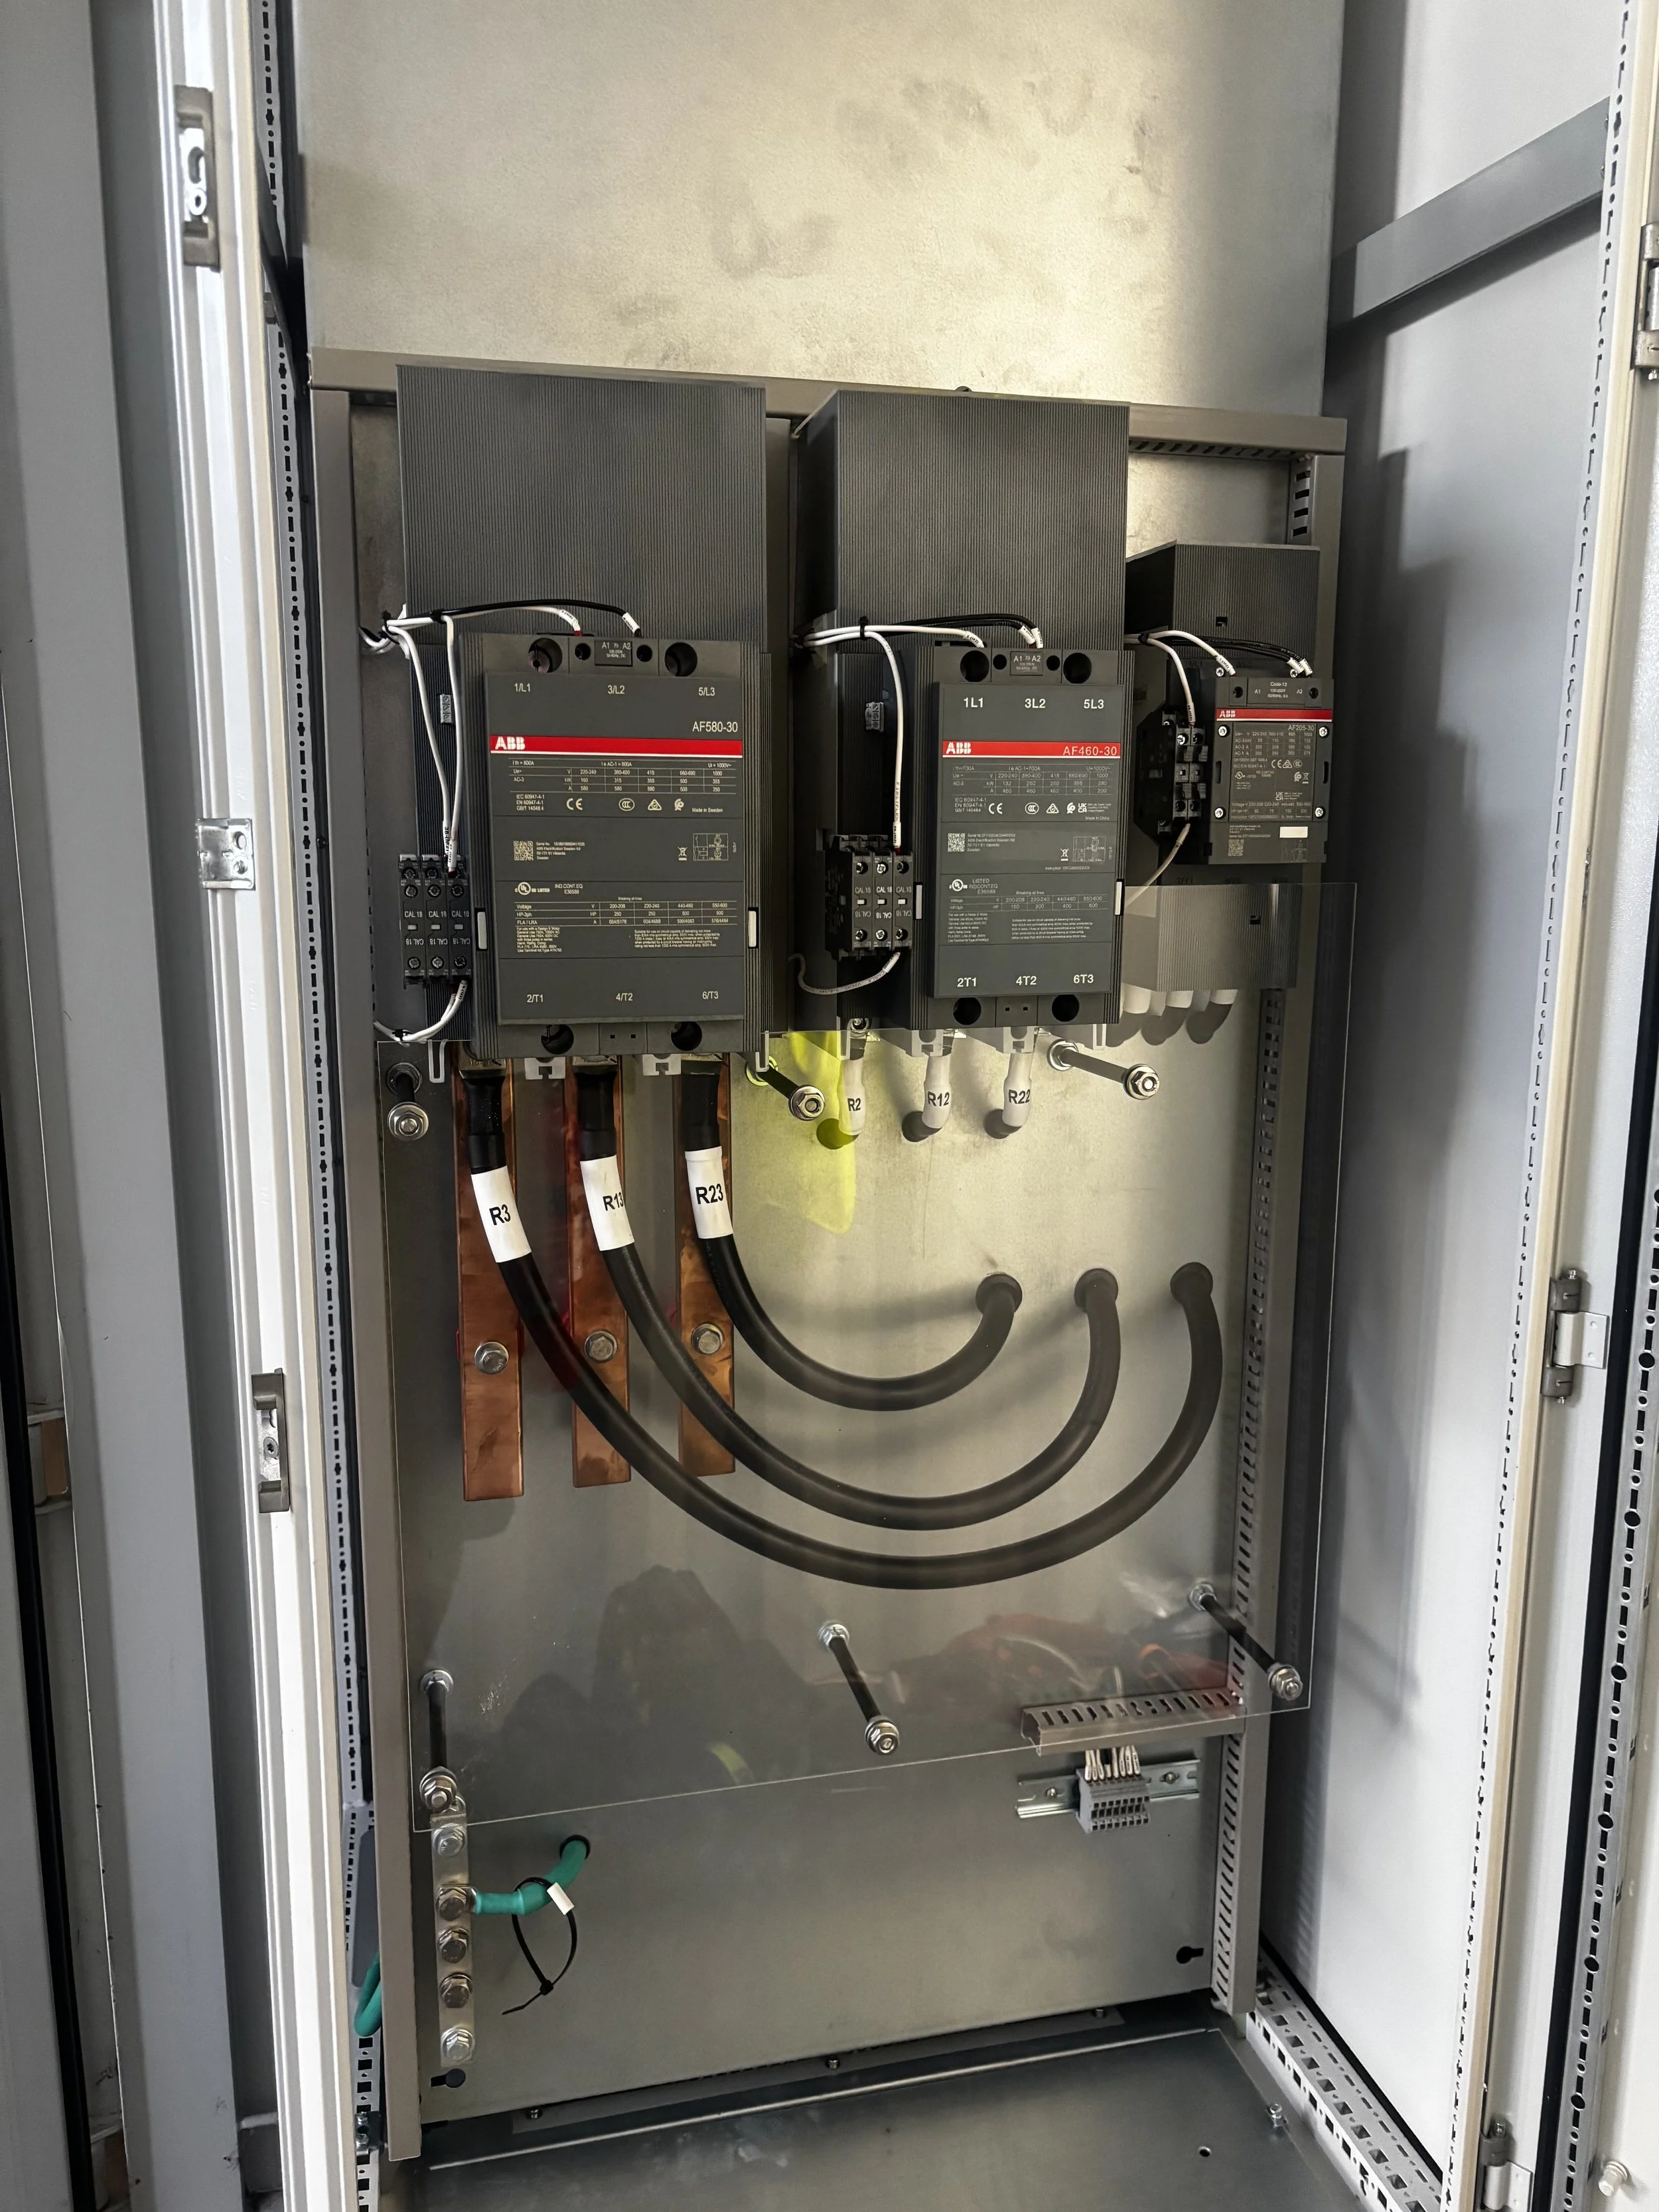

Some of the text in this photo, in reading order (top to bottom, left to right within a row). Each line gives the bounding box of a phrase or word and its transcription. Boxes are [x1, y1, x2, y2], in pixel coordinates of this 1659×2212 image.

[514, 683, 531, 693] 1/L1
[607, 685, 624, 694] 3/L2
[698, 687, 715, 697] 5/L3
[964, 698, 983, 708] 1L1
[1025, 698, 1046, 709] 3L2
[1084, 699, 1104, 709] 5L3
[692, 721, 738, 733] AF580-30
[495, 737, 525, 750] ABB
[946, 742, 972, 754] ABB
[1063, 746, 1117, 756] AF460-30
[957, 977, 977, 987] 2T1
[1016, 976, 1037, 985] 4T2
[1073, 974, 1094, 984] 6T3
[527, 994, 543, 1003] 2/T1
[616, 993, 633, 1002] 4/T2
[702, 991, 719, 999] 6/T3
[927, 1091, 950, 1107] R12
[1008, 1089, 1031, 1105] R22
[847, 1097, 861, 1112] R2
[695, 1183, 724, 1205] R23
[602, 1192, 624, 1211] R13
[489, 1204, 511, 1226] R3
